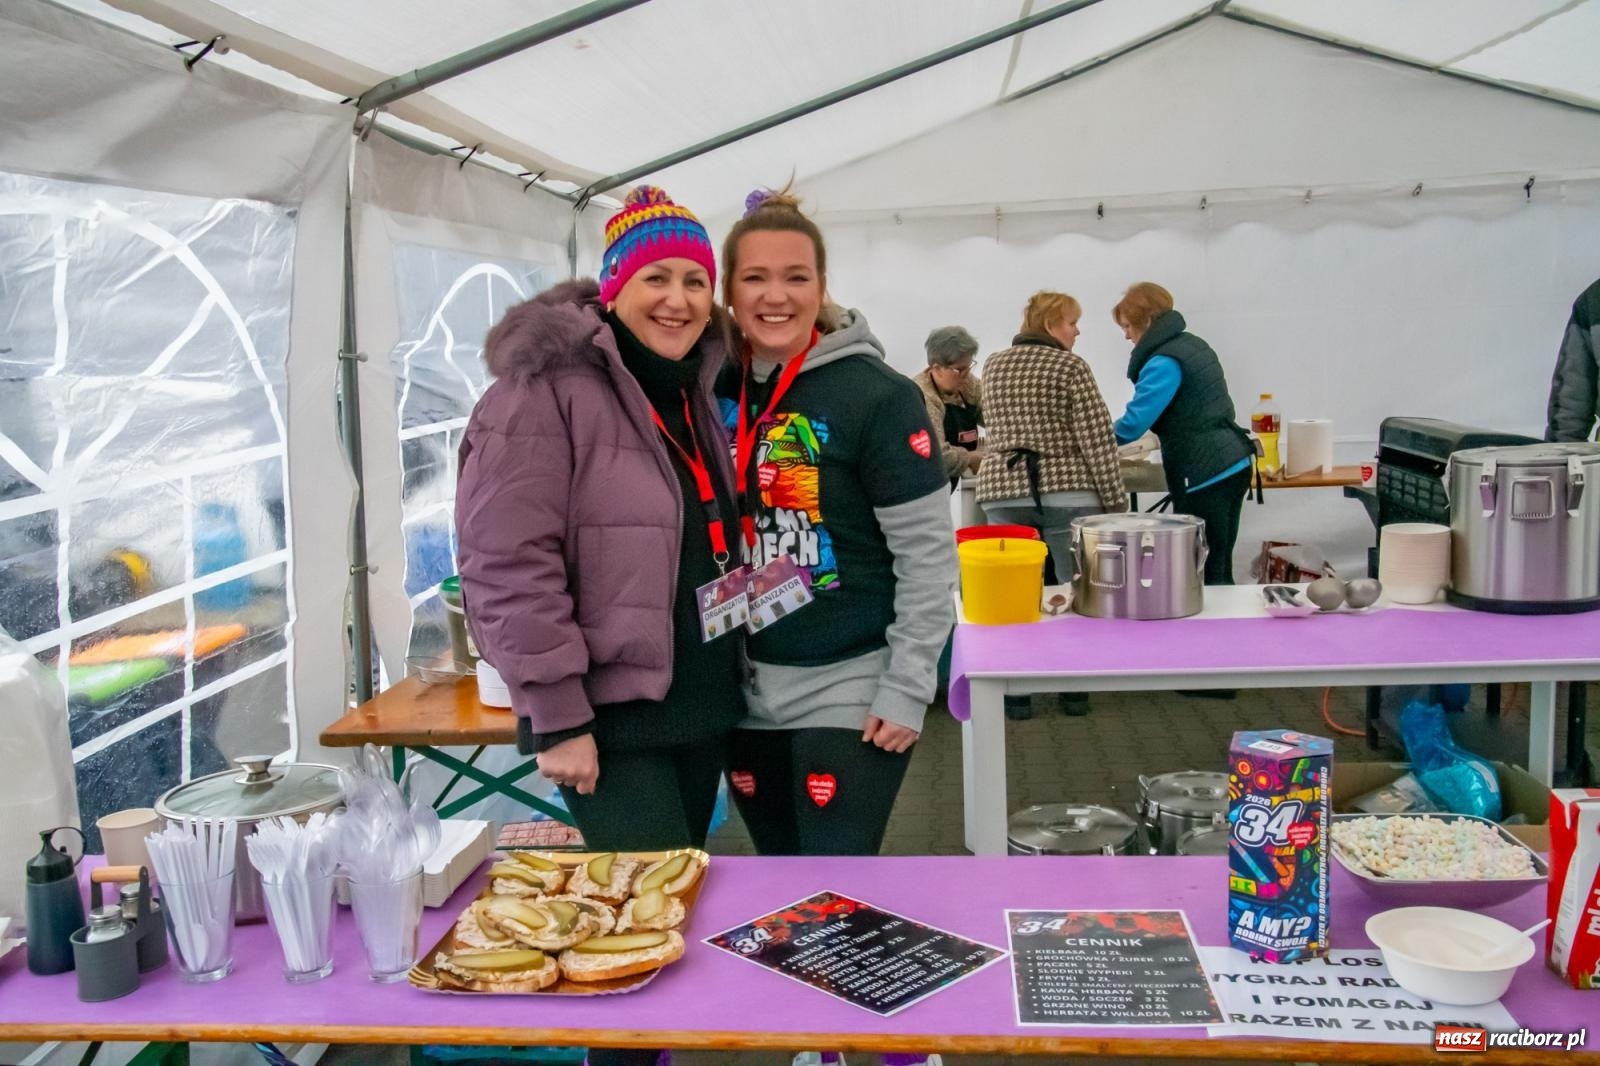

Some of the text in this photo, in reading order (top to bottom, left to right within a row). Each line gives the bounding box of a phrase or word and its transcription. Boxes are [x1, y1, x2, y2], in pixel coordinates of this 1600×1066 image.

[704, 587, 718, 608] 34
[750, 578, 801, 610] RGANIZATOR
[704, 594, 746, 621] ORGANIZATOR
[1245, 794, 1271, 806] 2026
[1237, 804, 1300, 845] 34
[793, 921, 851, 946] CENNIK
[1016, 918, 1068, 933] 34
[1237, 910, 1312, 938] A MY?
[734, 927, 774, 954] 34
[1065, 938, 1141, 946] CENNIK
[1235, 926, 1274, 945] ROBIMY
[1273, 936, 1309, 948] SWOJE
[851, 945, 884, 960] WYPIEKI
[1324, 957, 1383, 967] LOS
[829, 966, 857, 980] FRYTKI
[875, 958, 912, 976] HERBATA
[858, 980, 887, 993] WODA
[890, 963, 921, 978] SOCZEK
[871, 981, 904, 998] GRZANE
[902, 970, 927, 982] WINO
[882, 984, 920, 1002] HERBATA
[1251, 994, 1434, 1010] I POMAGAJ
[1228, 1013, 1342, 1029] RAZEM
[1352, 1018, 1375, 1030] Z
